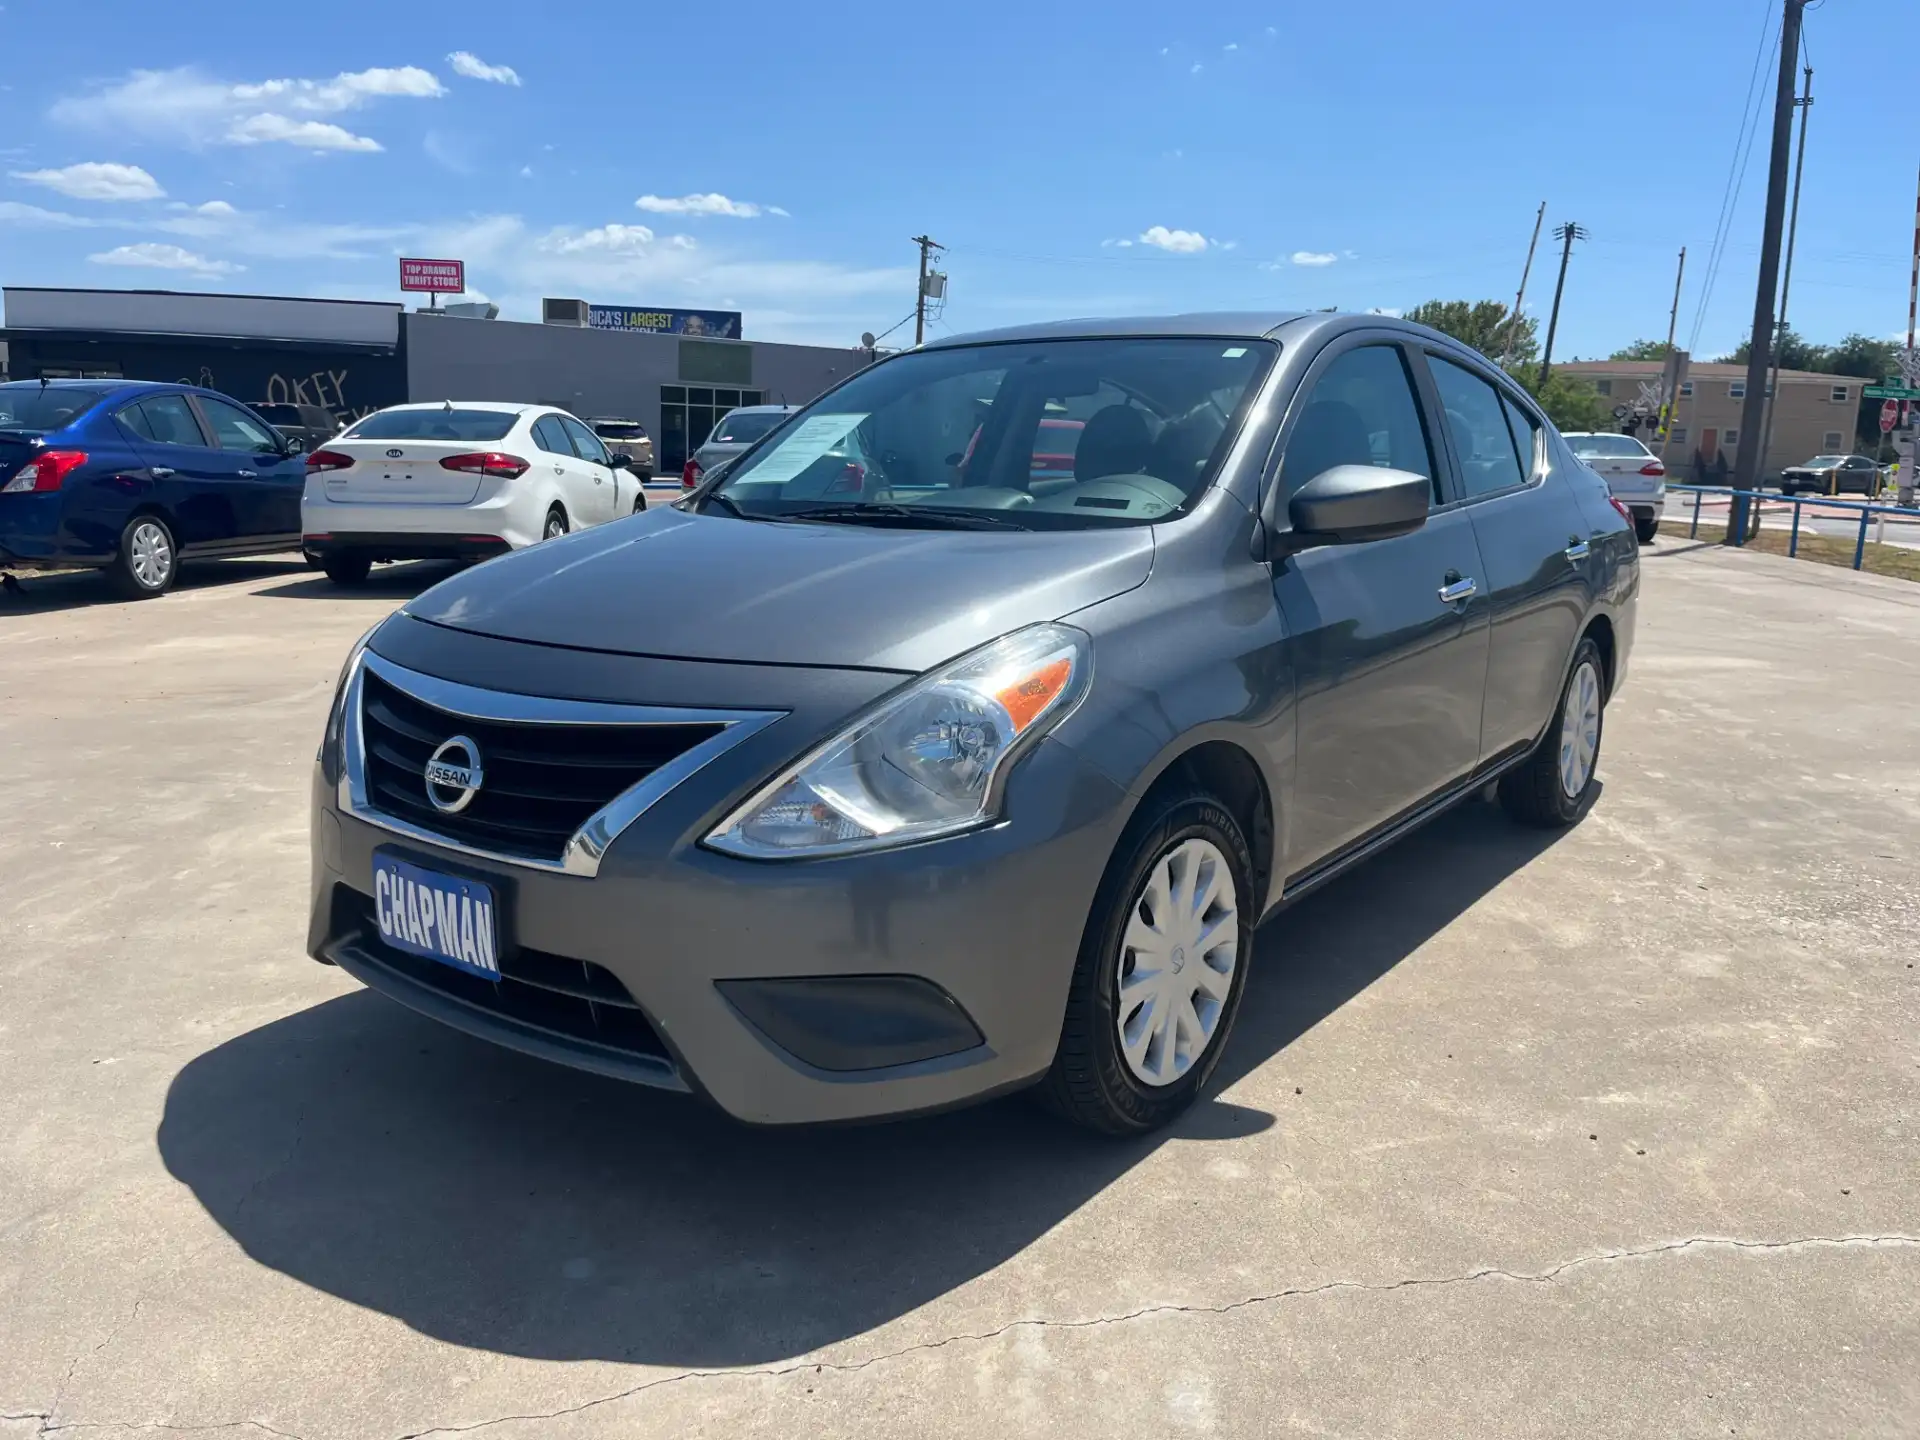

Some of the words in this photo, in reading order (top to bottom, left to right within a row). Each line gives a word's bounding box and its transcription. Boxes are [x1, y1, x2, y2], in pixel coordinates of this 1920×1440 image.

[405, 264, 421, 274] TOP
[422, 265, 457, 276] DRAWER
[404, 275, 431, 286] THRIFT
[433, 277, 459, 287] STORE
[623, 312, 673, 328] LARGEST
[267, 369, 348, 408] OKEY
[426, 763, 472, 785] NISSAN
[375, 868, 496, 972] CHAPMAN
